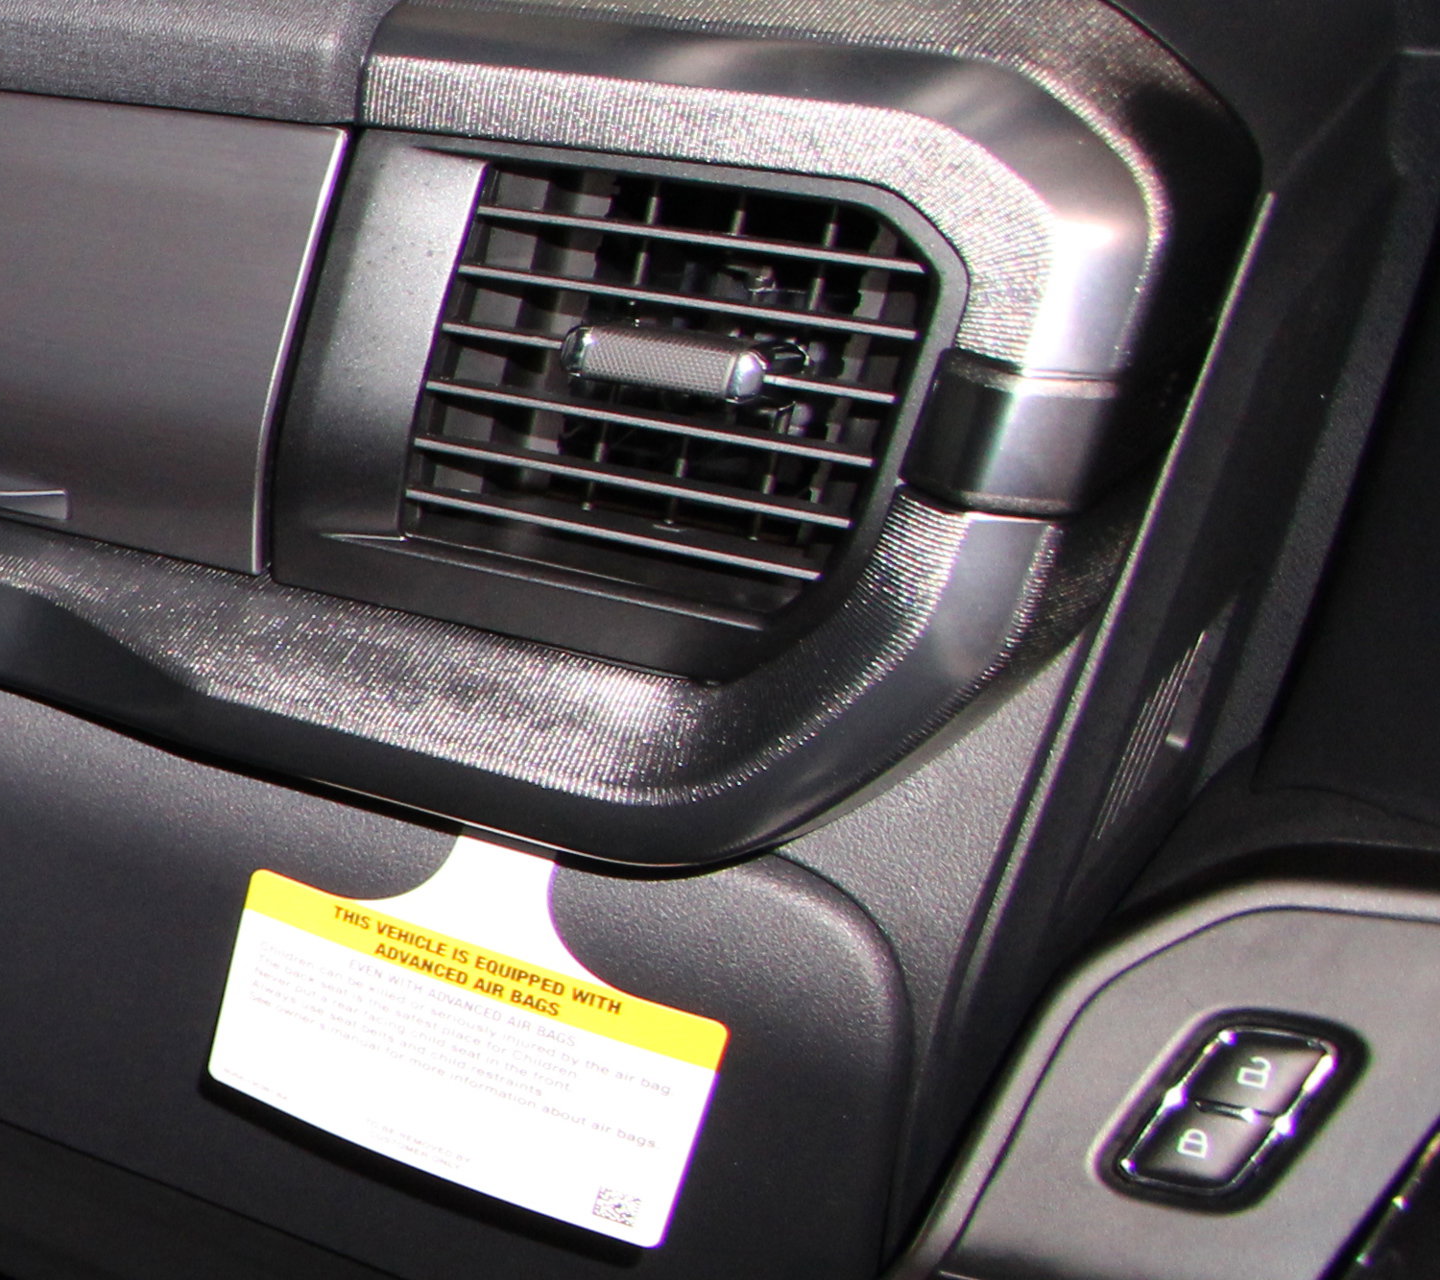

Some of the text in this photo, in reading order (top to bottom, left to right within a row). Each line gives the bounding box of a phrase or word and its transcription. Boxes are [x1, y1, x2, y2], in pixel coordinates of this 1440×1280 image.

[335, 905, 622, 1015] THIS VEHICLE IS EQUIPPED WITH
[348, 958, 576, 1048] EVEN WITH ADVANCED AIR BAGS
[374, 943, 560, 1017] ADVANCED AIR BAGS
[319, 967, 343, 979] can
[347, 976, 364, 989] be
[410, 1001, 425, 1010] or
[430, 1007, 498, 1039] seriously
[502, 1034, 557, 1058] injured
[560, 1051, 580, 1067] by
[584, 1059, 610, 1077] the
[613, 1071, 636, 1083] air
[320, 981, 349, 996] seat
[368, 998, 390, 1014] the
[395, 1009, 438, 1031] safest
[441, 1027, 482, 1047] place
[486, 1040, 507, 1055] for
[320, 995, 328, 1003] a
[450, 1044, 481, 1061] seat
[485, 1056, 500, 1066] in
[504, 1061, 528, 1077] the
[399, 1040, 427, 1056] and
[430, 1051, 467, 1070] child
[275, 1004, 326, 1031] owners
[408, 1057, 446, 1078] more
[449, 1073, 537, 1109] information
[540, 1105, 587, 1126] about
[590, 1121, 613, 1134] air
